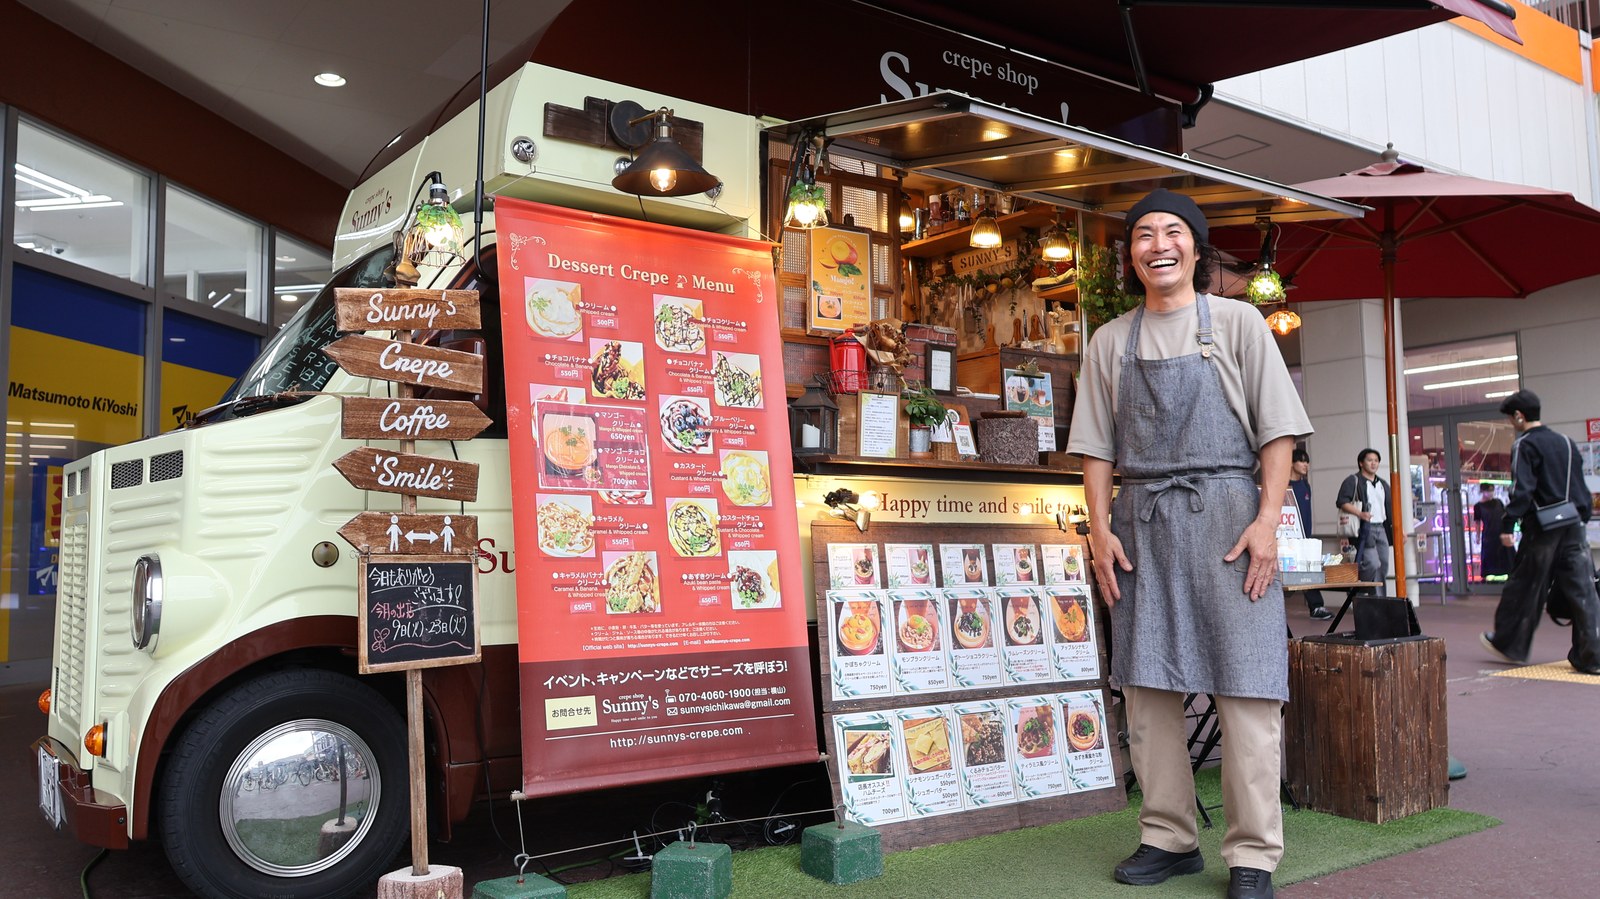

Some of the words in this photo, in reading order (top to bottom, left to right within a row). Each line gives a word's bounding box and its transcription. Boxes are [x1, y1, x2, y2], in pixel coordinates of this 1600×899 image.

[942, 50, 992, 79] crepe
[997, 62, 1038, 96] shop
[352, 190, 392, 232] Sunny's
[548, 253, 614, 277] Dessert
[620, 265, 669, 286] Crepe
[692, 274, 735, 294] Menu
[366, 293, 457, 328] Sunny's
[584, 302, 610, 310] クリーム
[596, 318, 614, 326] 500円
[706, 317, 740, 326] チョコクリーム
[379, 344, 453, 380] Crepe
[552, 354, 587, 364] チョコバナナ
[8, 382, 91, 409] Matsumoto
[92, 396, 138, 417] KiYoshi
[380, 402, 450, 434] Coffee
[610, 433, 635, 441] 650yen
[378, 456, 444, 490] Smile
[612, 478, 637, 486] 700yen
[937, 495, 973, 514] time
[978, 496, 1007, 514] and
[1280, 513, 1295, 525] CC
[368, 566, 435, 587] 今日もありがとう
[371, 602, 415, 620] 今月の出店
[552, 707, 592, 718] お問合せ先
[602, 696, 659, 715] Sunny's
[680, 698, 790, 714] sunnysichikawa@gmail.com
[610, 726, 743, 748] http://sunnys-crepe.com
[1021, 760, 1058, 768] ティラミス風クリーム
[863, 788, 886, 796] ハムチーズ
